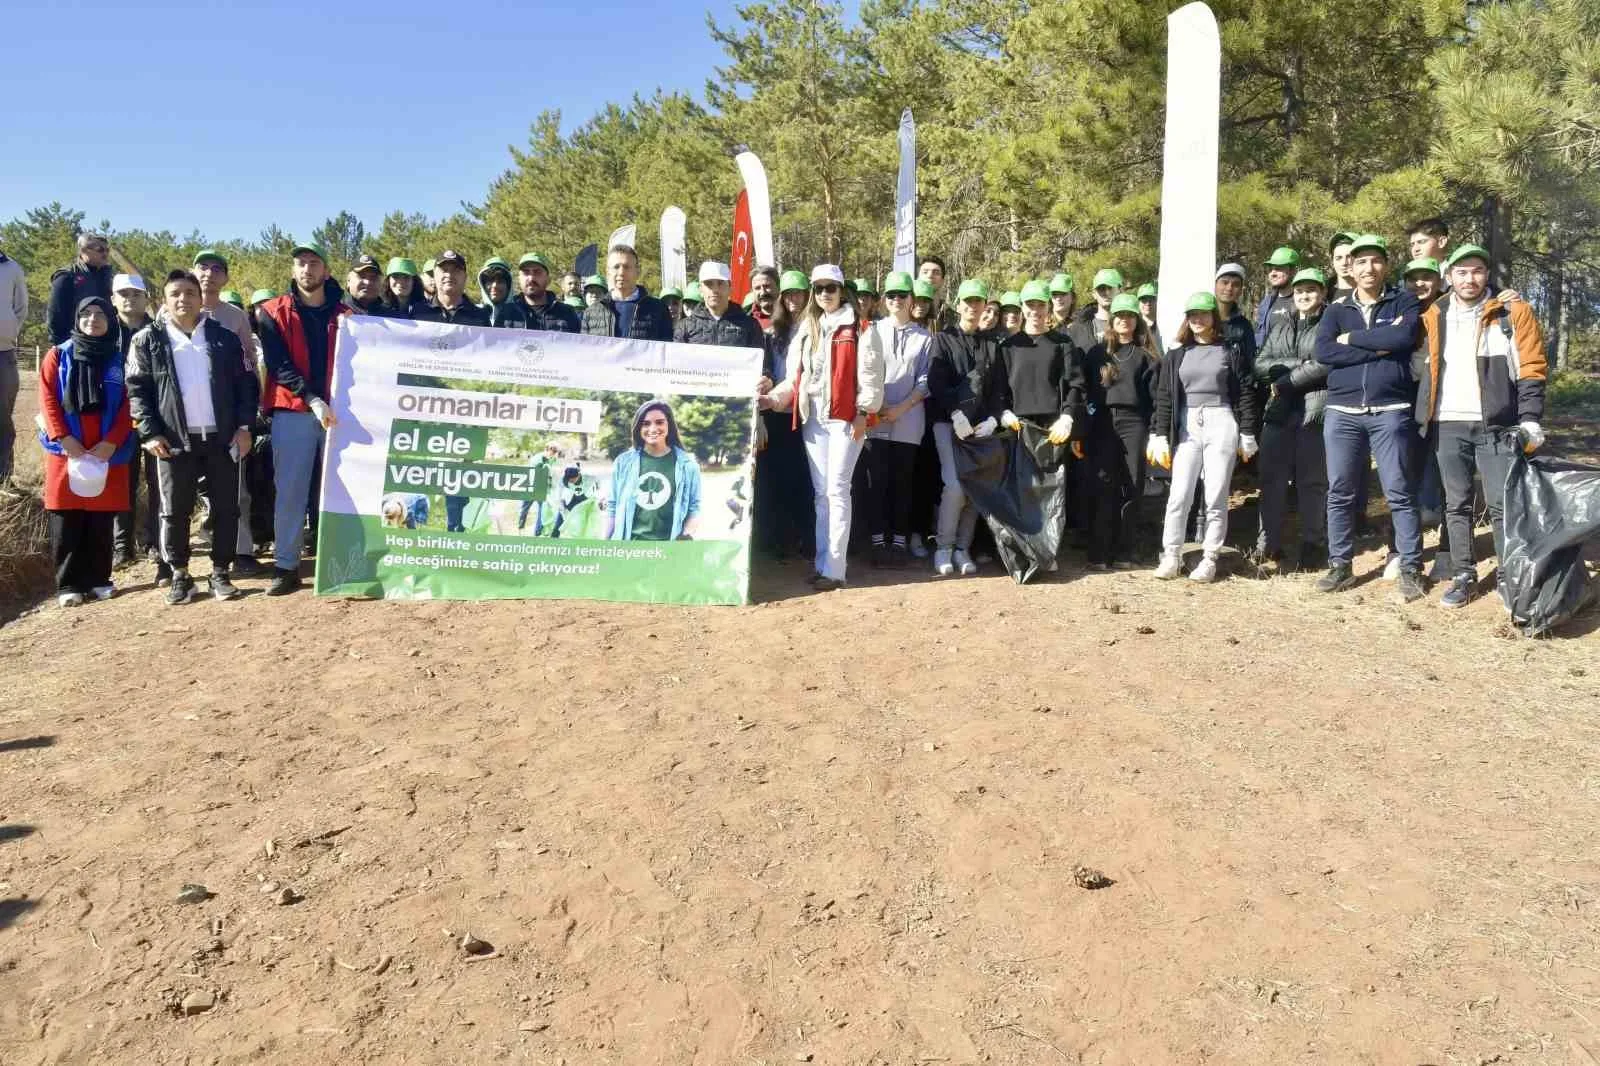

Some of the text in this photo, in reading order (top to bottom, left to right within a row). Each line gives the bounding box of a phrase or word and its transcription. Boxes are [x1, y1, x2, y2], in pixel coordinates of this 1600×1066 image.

[399, 394, 583, 429] ormanlar için
[393, 428, 471, 455] el ele
[390, 463, 536, 495] veriyoruz!
[385, 534, 413, 548] Hep
[417, 536, 471, 551] birlikte
[475, 542, 571, 556] ormanlarımızı
[383, 553, 600, 576] geleceğimize sahip çıkıyoruz!
